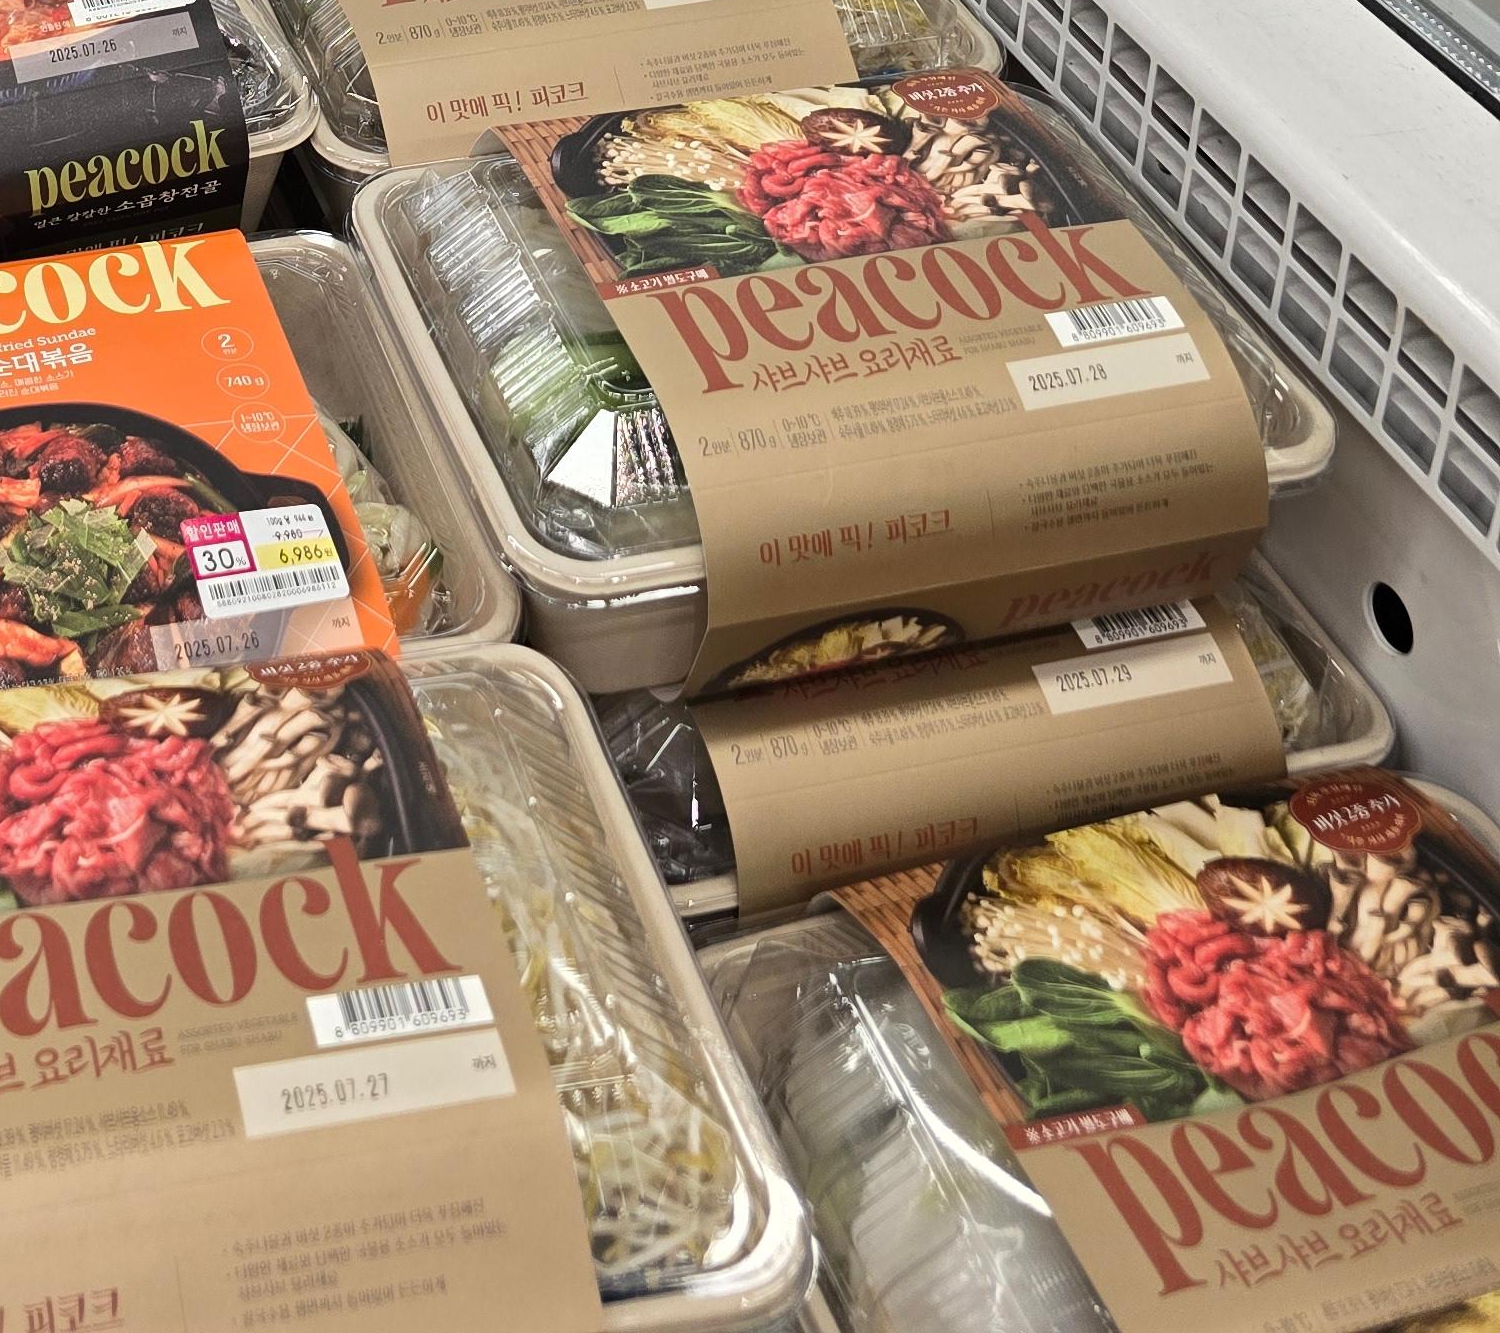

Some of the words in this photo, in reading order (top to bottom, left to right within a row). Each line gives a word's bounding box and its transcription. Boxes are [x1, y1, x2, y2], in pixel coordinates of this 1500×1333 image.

[49, 38, 118, 63] 2025.07.26
[427, 102, 445, 124] 이
[450, 97, 489, 123] 맛에
[492, 91, 521, 114] 픽!
[530, 82, 588, 107] 피코크
[23, 119, 230, 218] peacock
[114, 179, 222, 213] 소곱창전골
[645, 210, 1152, 394] peacock
[36, 325, 97, 347] Sundae
[217, 334, 235, 348] 2
[752, 352, 858, 393] 샤브샤브
[859, 335, 963, 379] 요리재료
[1029, 363, 1109, 393] 2025.07.28
[225, 375, 253, 387] 740
[738, 429, 766, 452] 870
[185, 520, 241, 543] 할인판매
[760, 542, 781, 566] 이
[788, 529, 833, 558] 맛에
[839, 520, 874, 551] 픽!
[885, 508, 956, 544] 피코크
[202, 547, 247, 573] 30%
[1000, 550, 1224, 630] peacock
[175, 631, 260, 661] 2025.07.26
[1056, 663, 1133, 692] 2025.07.29
[770, 735, 798, 758] 870
[791, 851, 811, 875] 이
[819, 839, 862, 868] 맛에
[915, 817, 978, 851] 피코크
[232, 1012, 299, 1030] VEGETABLE
[33, 1026, 176, 1089] 요리재료
[471, 1054, 498, 1071] 까지
[282, 1072, 390, 1115] 2025.07.27
[1217, 1230, 1345, 1291] 샤브샤브
[1345, 1190, 1465, 1261] 요리재료
